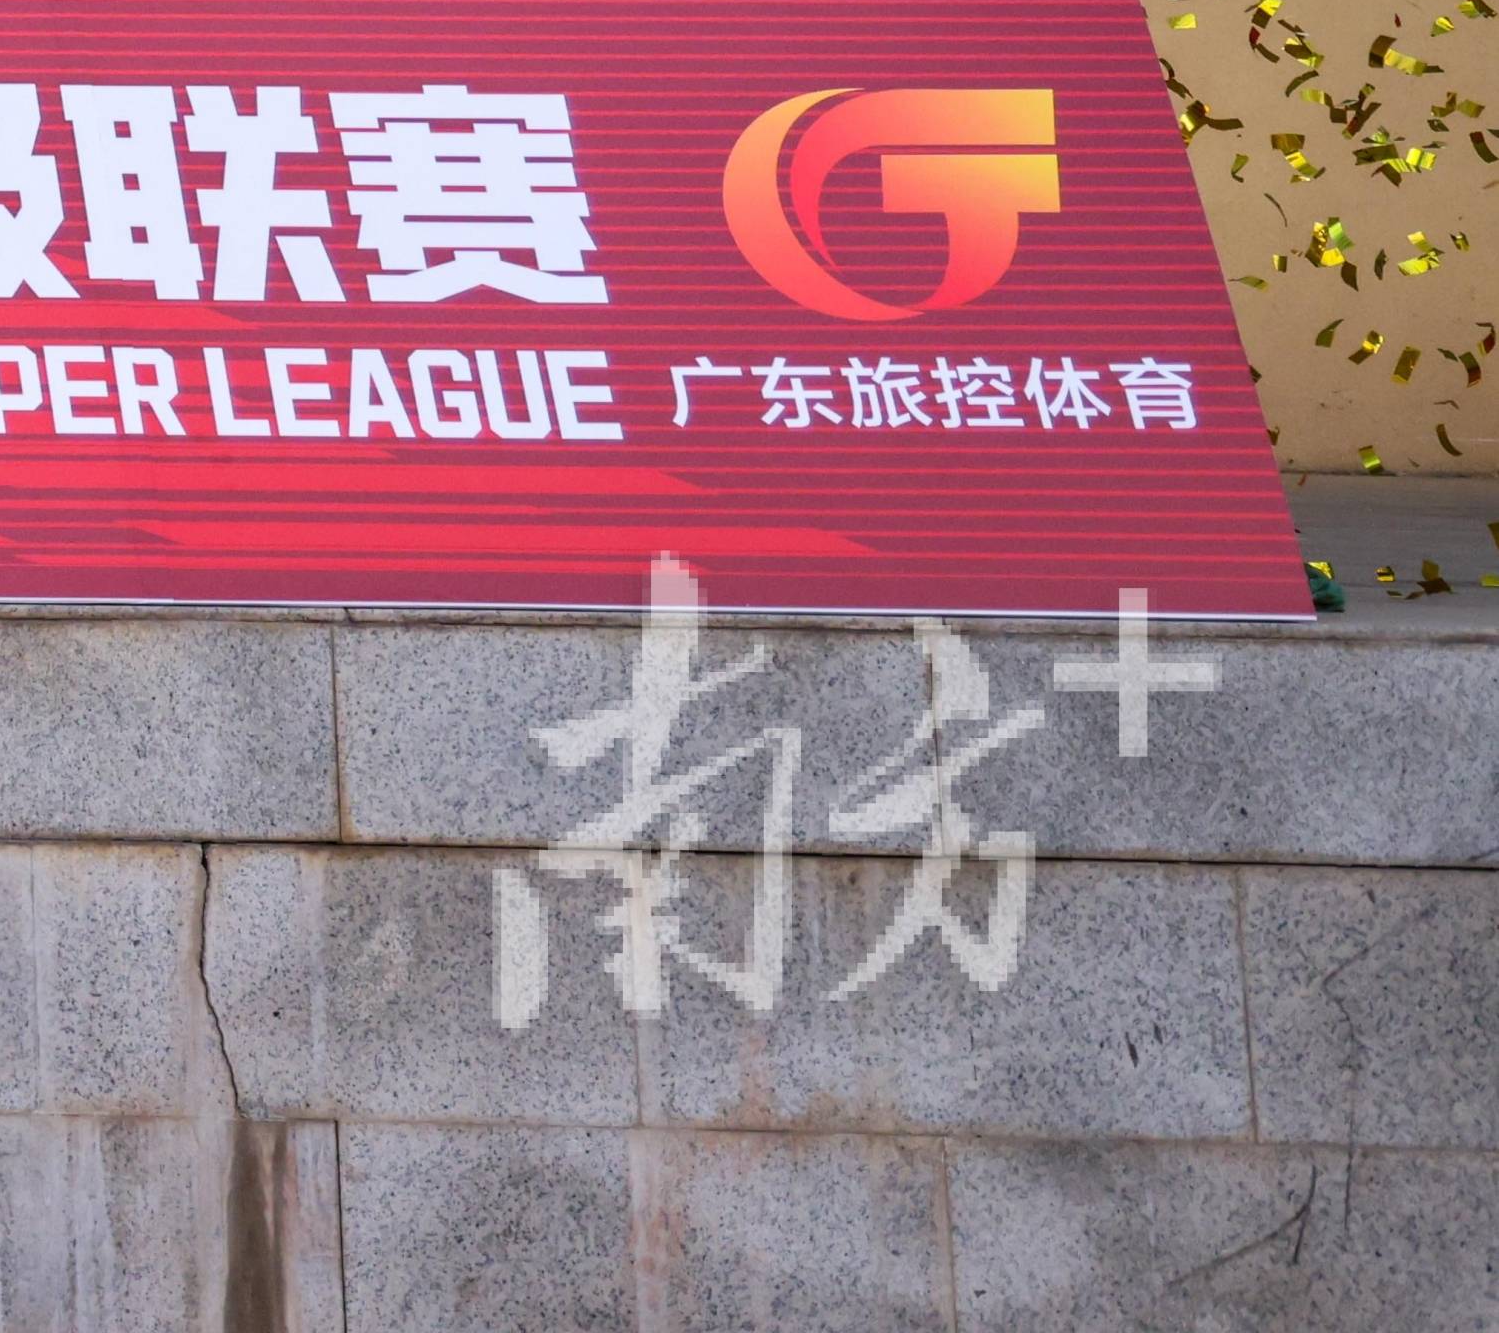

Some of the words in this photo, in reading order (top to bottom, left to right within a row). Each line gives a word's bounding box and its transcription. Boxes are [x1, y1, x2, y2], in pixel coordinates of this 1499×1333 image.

[202, 347, 625, 440] LEAGUE
[670, 356, 1198, 430] 广东旅控体育
